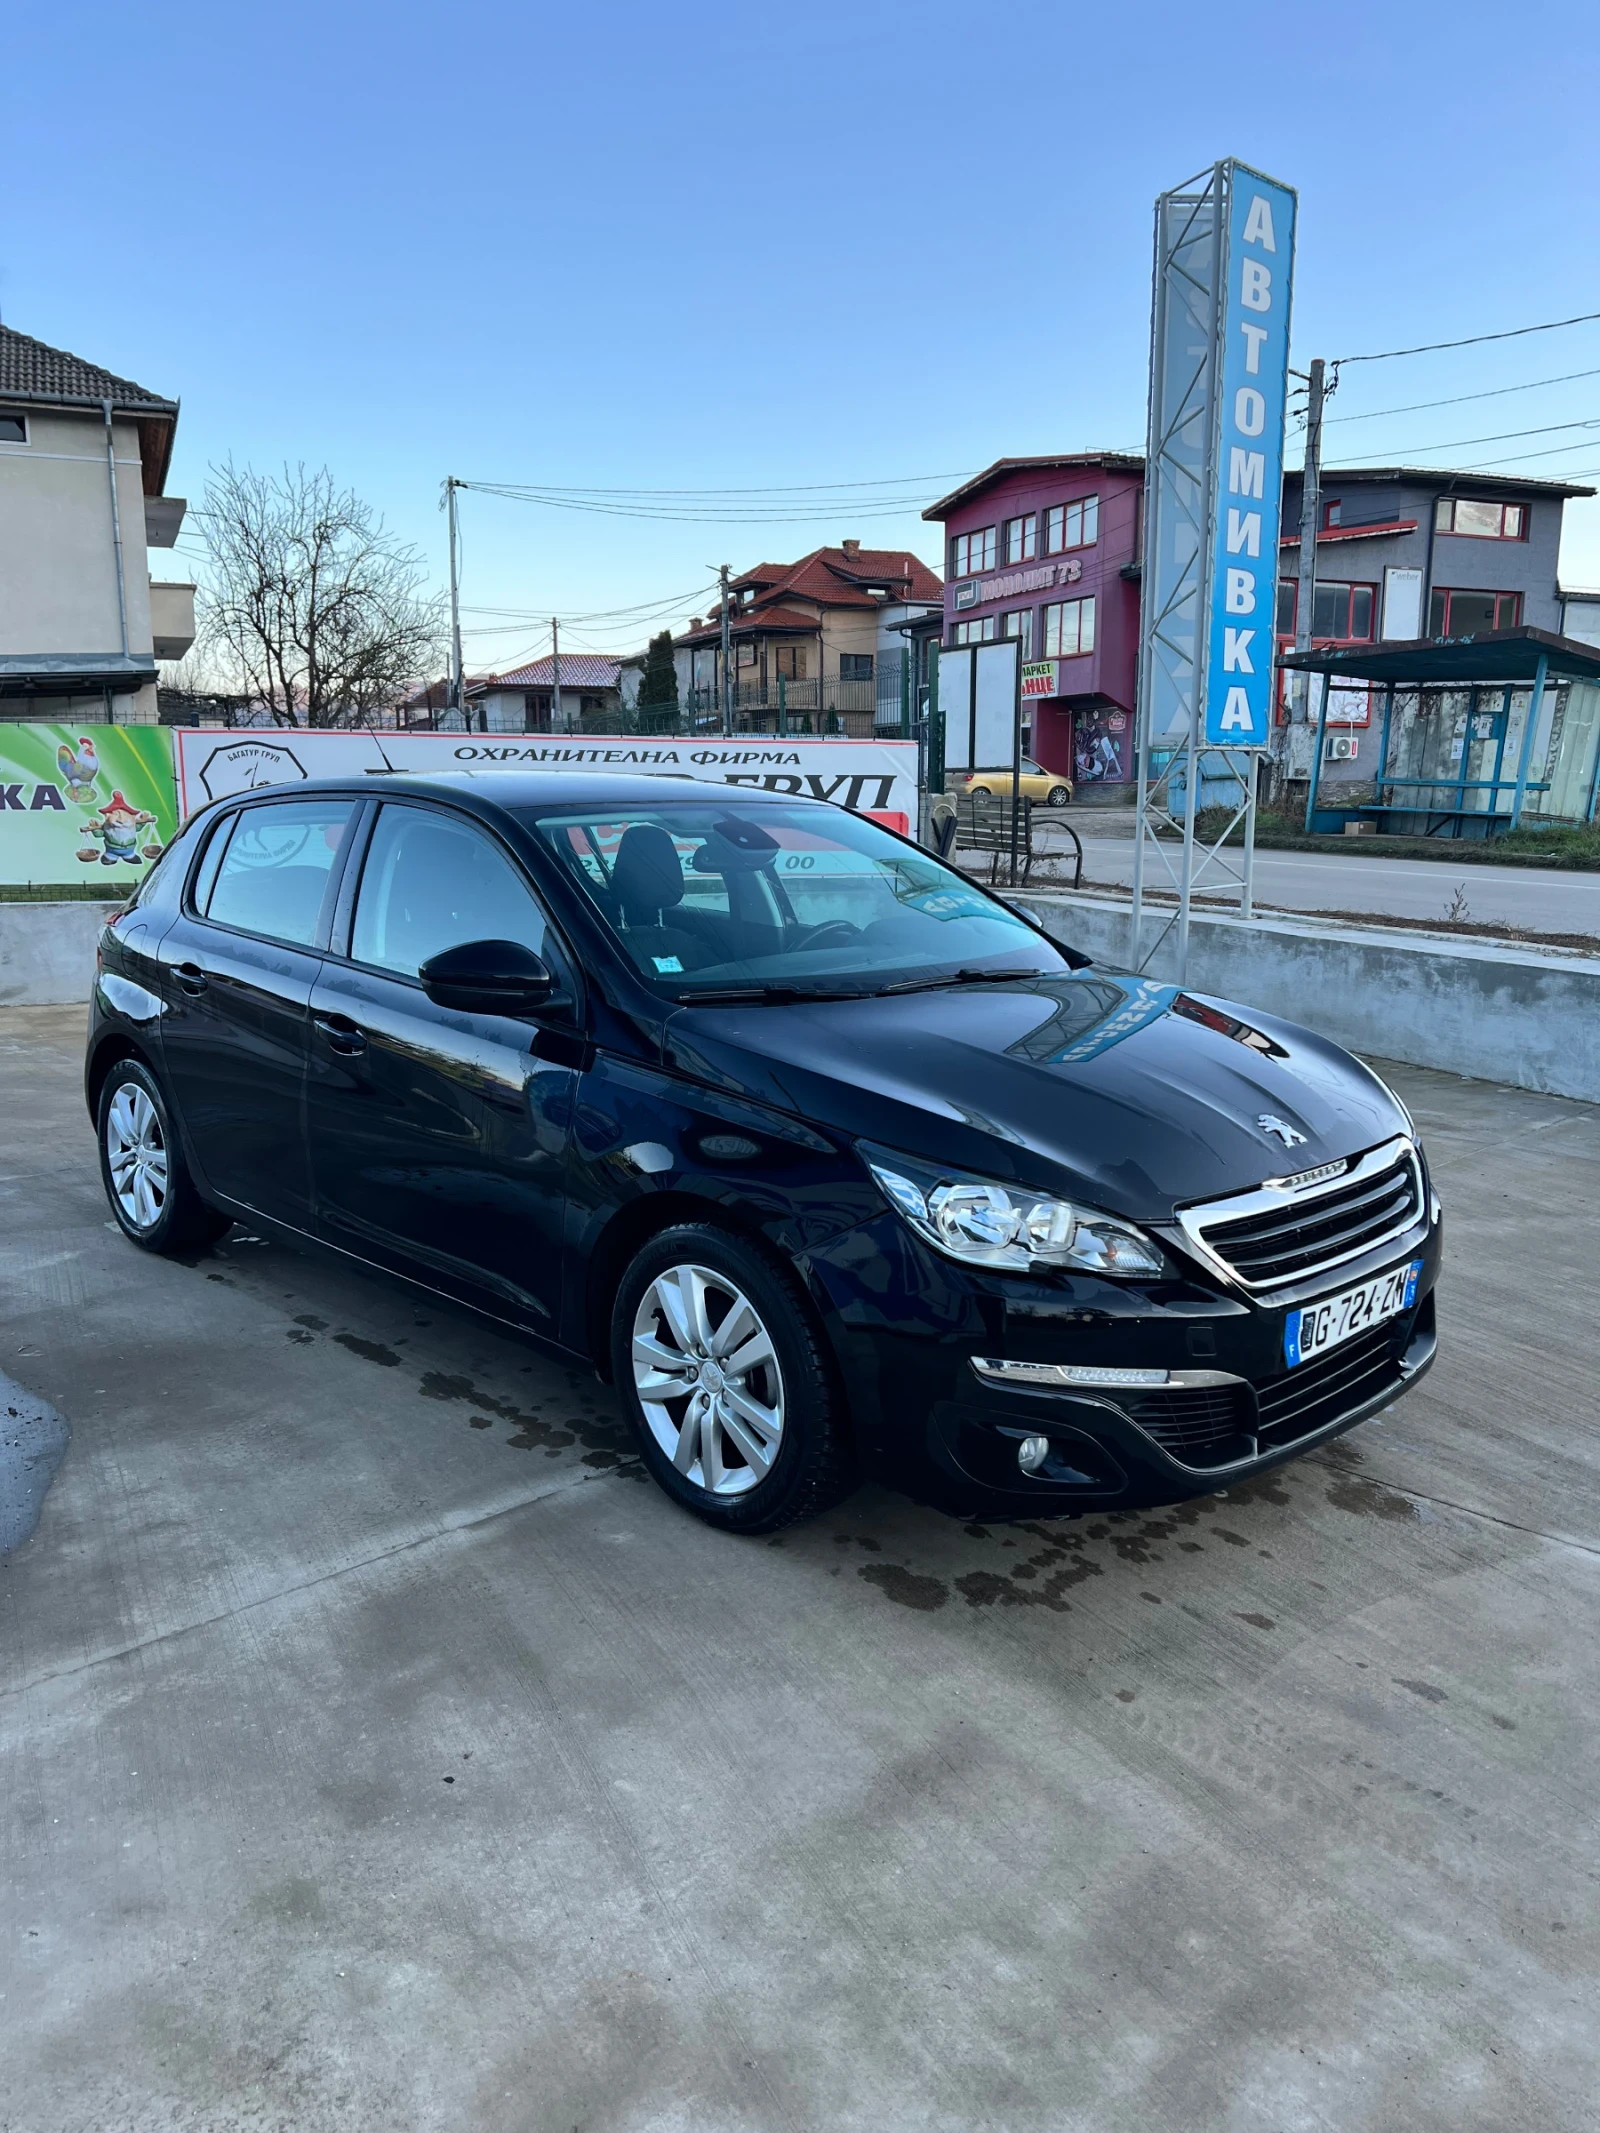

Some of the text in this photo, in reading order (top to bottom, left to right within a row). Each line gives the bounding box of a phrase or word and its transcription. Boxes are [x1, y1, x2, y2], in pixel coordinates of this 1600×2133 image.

[1220, 194, 1276, 731] АВТОМИВКА
[980, 565, 1056, 602] МОНОЛИТ
[1057, 560, 1082, 585] 73
[1397, 572, 1419, 581] weber
[227, 749, 281, 763] БАГАТУР ГРУП
[453, 746, 802, 765] ОХРАНИТЕЛНА ФИРМА
[724, 774, 898, 809] РУП
